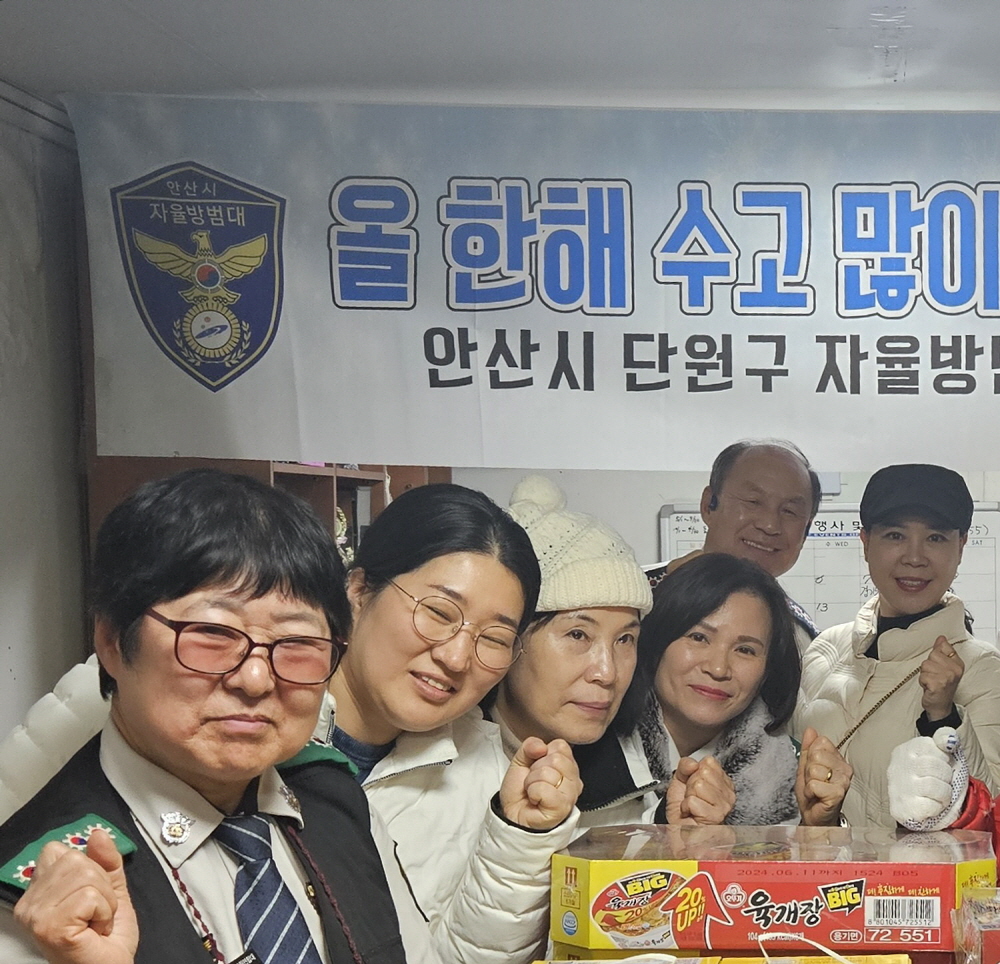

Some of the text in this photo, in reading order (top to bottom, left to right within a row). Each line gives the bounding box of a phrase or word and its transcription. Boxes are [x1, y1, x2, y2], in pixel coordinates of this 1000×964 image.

[166, 180, 217, 197] 안산시
[150, 203, 246, 227] 자율방범대
[328, 176, 419, 311] 올
[438, 176, 634, 316] 한해
[652, 180, 816, 316] 수고
[422, 326, 596, 392] 안산시
[622, 331, 790, 394] 단원구
[816, 602, 829, 612] 13
[737, 869, 843, 877] 2024.06.11까지
[853, 869, 884, 877] 1524
[626, 874, 668, 896] BIG
[826, 887, 861, 909] BIG
[624, 907, 643, 921] 20
[742, 890, 825, 929] 육개장
[833, 931, 859, 941] 용기면
[867, 929, 933, 941] 72 551
